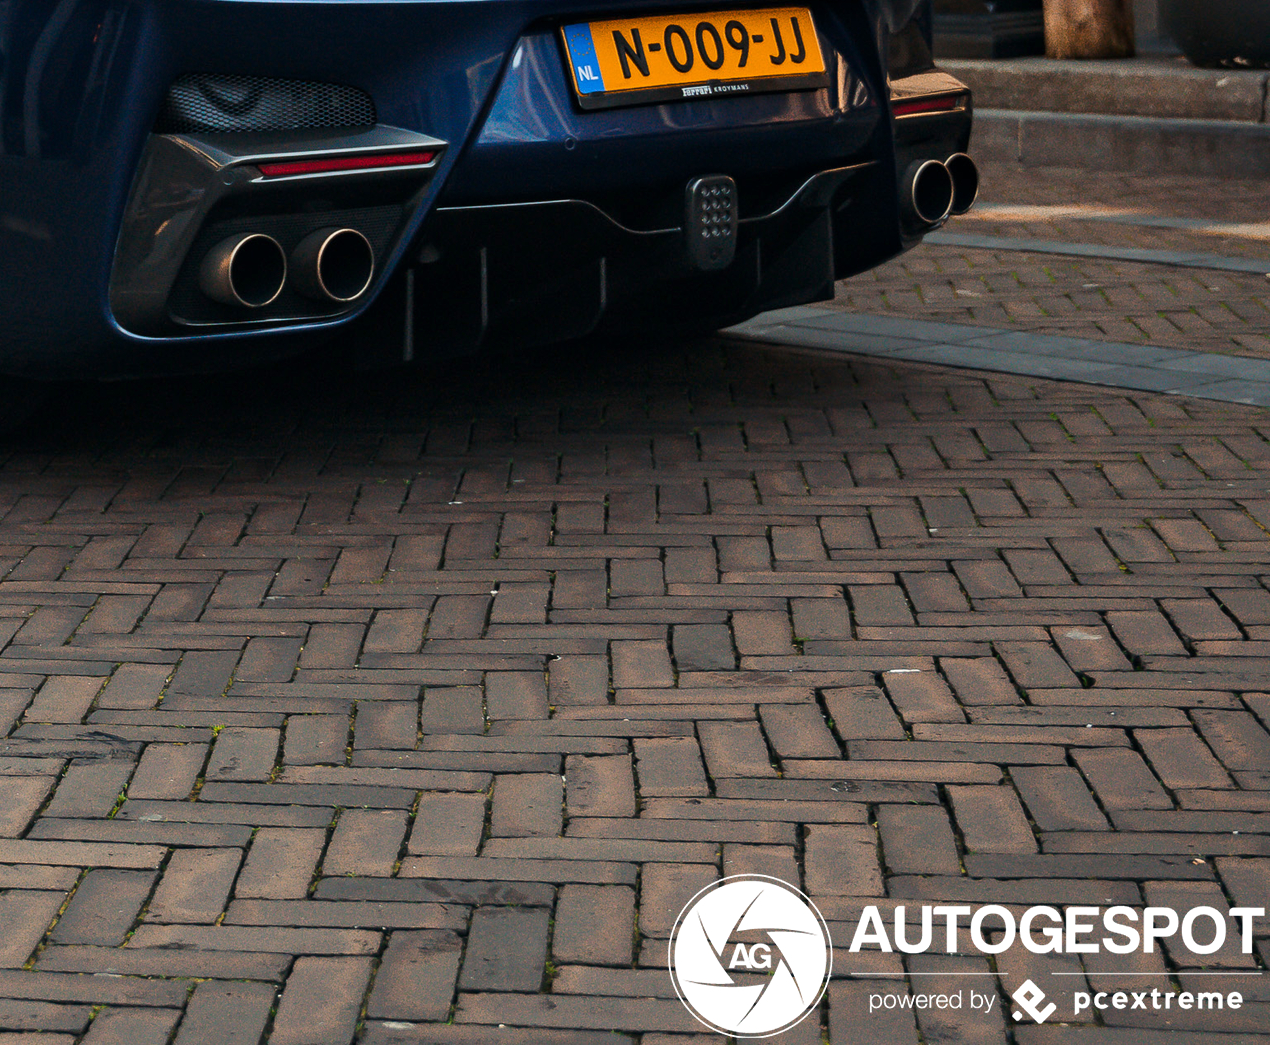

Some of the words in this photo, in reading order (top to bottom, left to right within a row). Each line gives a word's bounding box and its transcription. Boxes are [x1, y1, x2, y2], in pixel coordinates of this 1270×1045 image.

[611, 16, 806, 80] N-009-JJ
[577, 65, 599, 81] NL
[681, 85, 712, 97] Ferrari
[713, 83, 749, 93] KROYMANS
